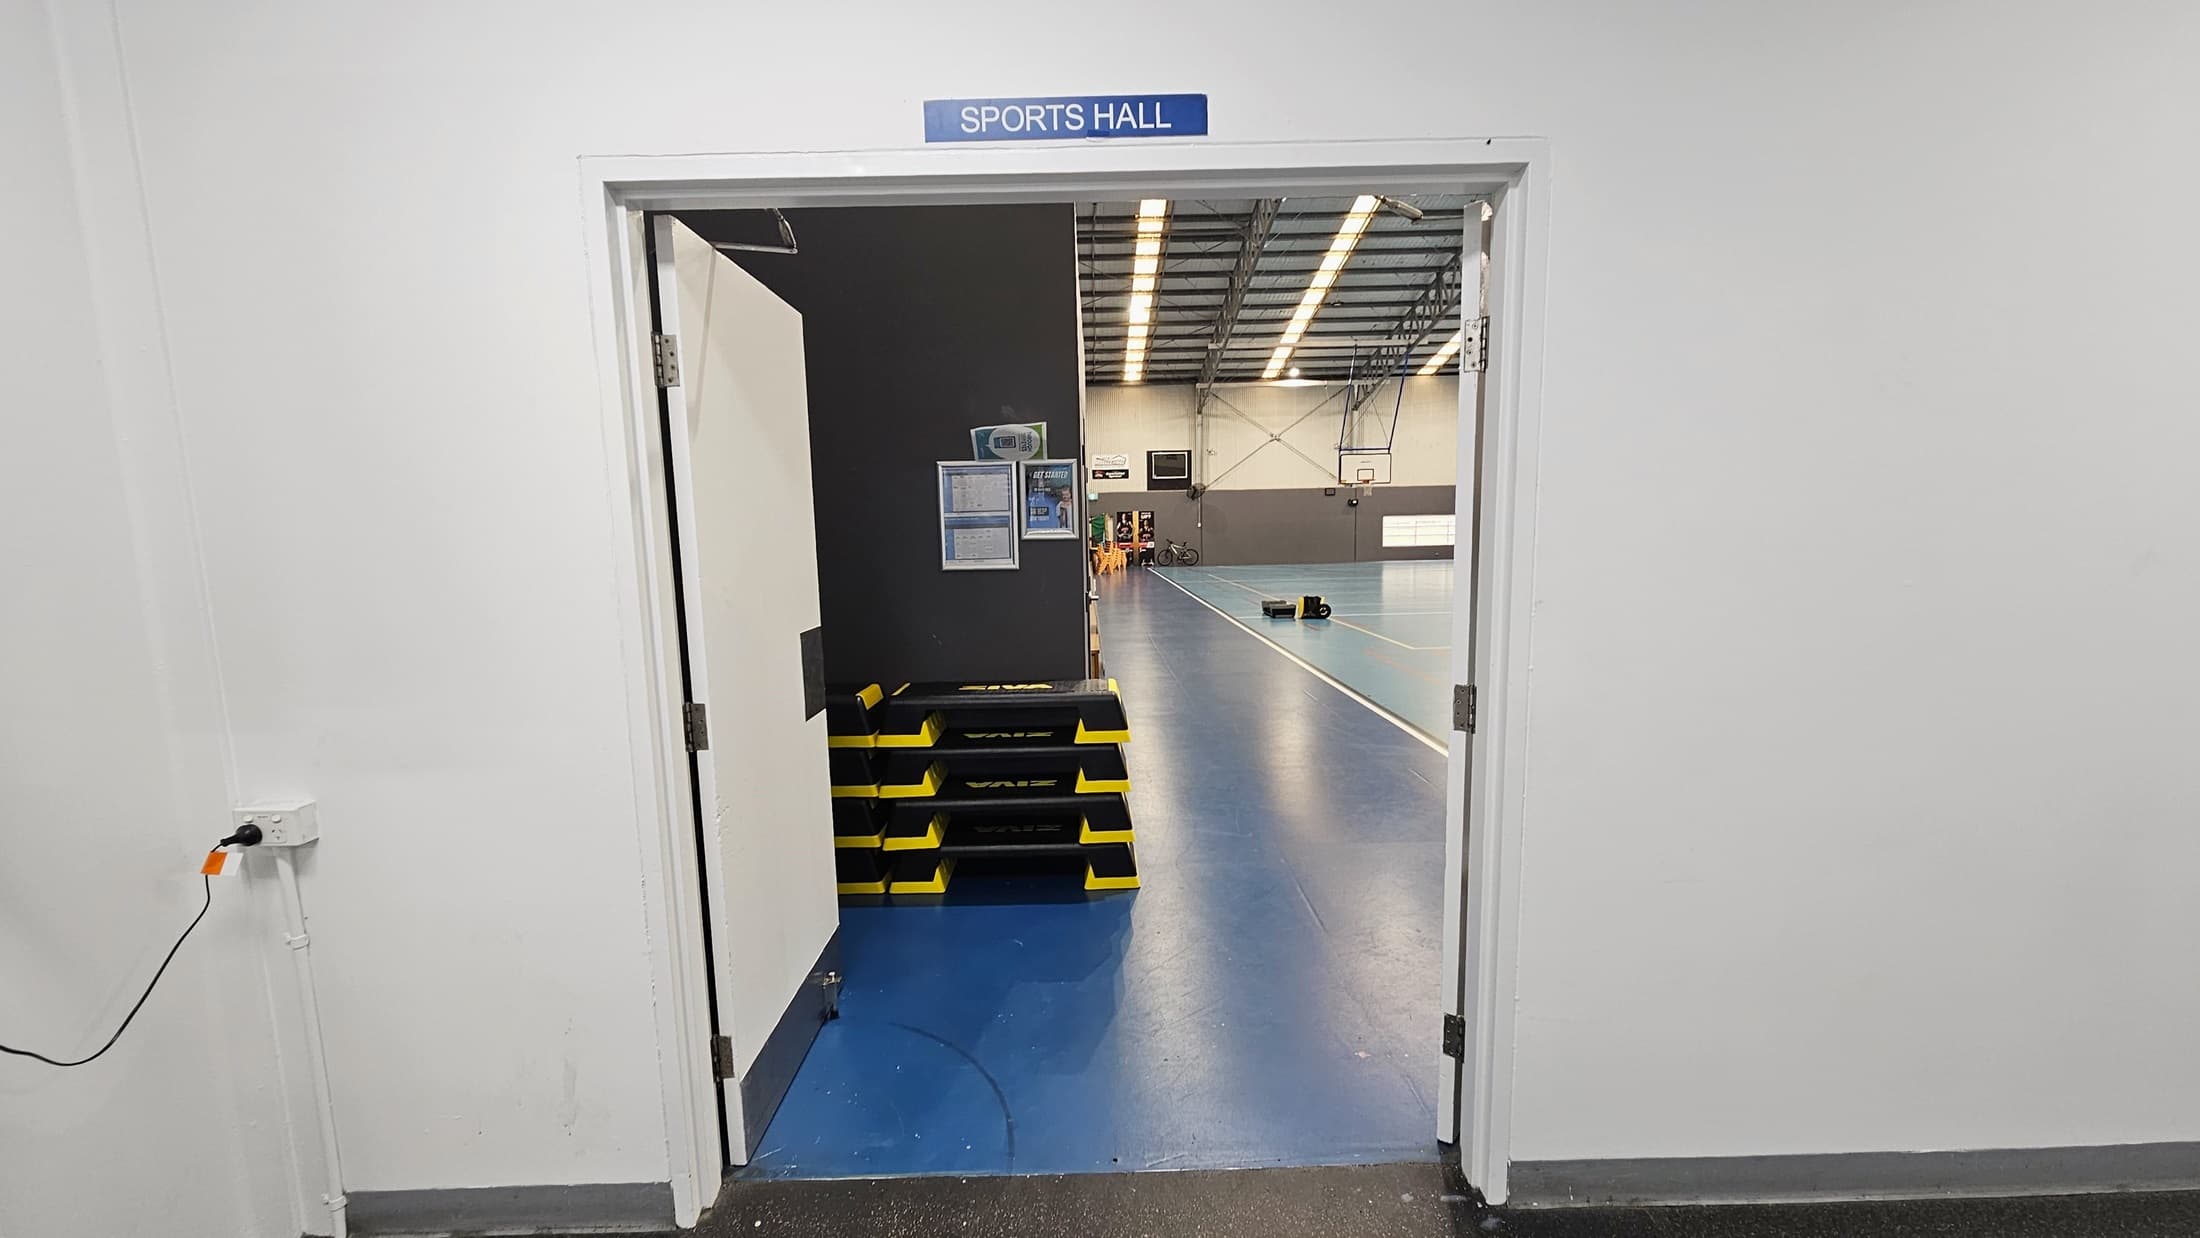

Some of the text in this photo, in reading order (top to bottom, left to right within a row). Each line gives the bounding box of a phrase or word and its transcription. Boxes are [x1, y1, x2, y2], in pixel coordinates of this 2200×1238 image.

[961, 102, 1172, 133] SPORTS HALL
[1033, 471, 1069, 479] GET STARTED
[965, 780, 1058, 788] ZIVA
